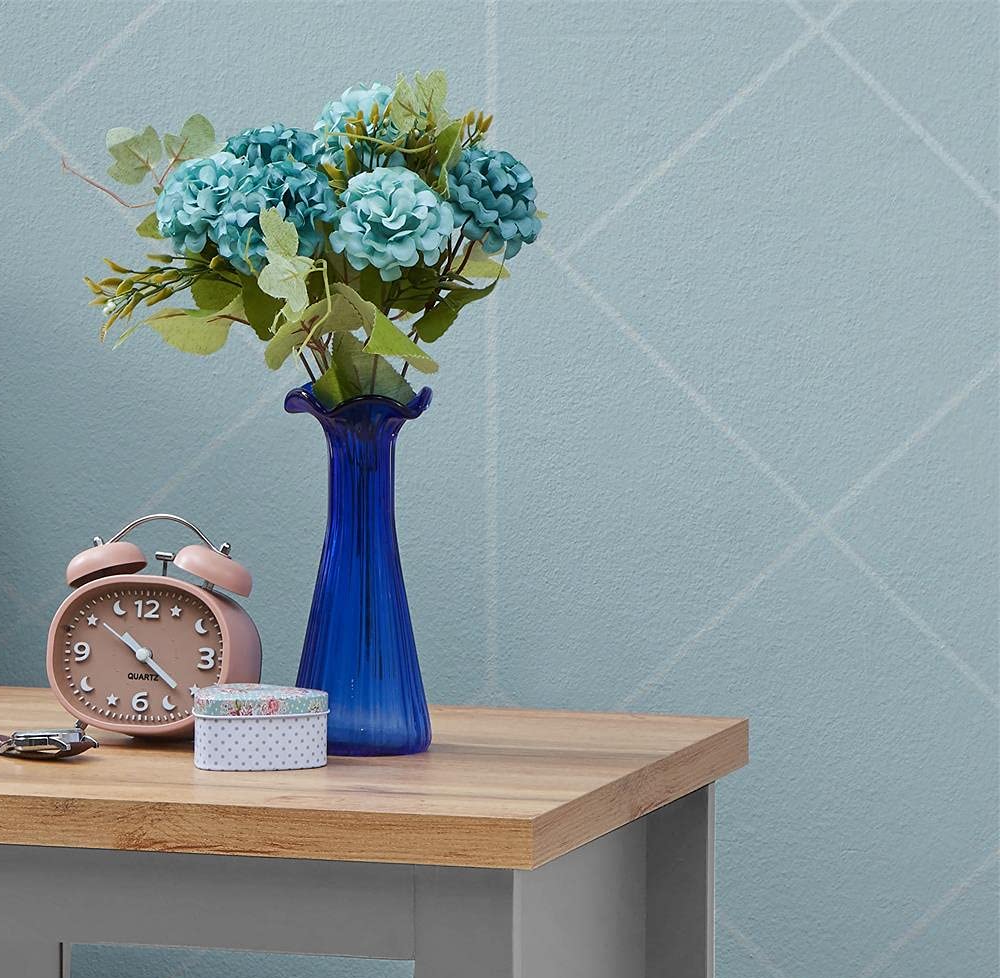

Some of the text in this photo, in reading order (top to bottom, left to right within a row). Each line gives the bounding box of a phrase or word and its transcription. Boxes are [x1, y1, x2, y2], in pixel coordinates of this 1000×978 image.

[134, 599, 160, 619] 12
[73, 641, 91, 663] 9
[196, 647, 216, 670] 3
[127, 672, 160, 682] QUARTZ
[131, 691, 149, 712] 6
